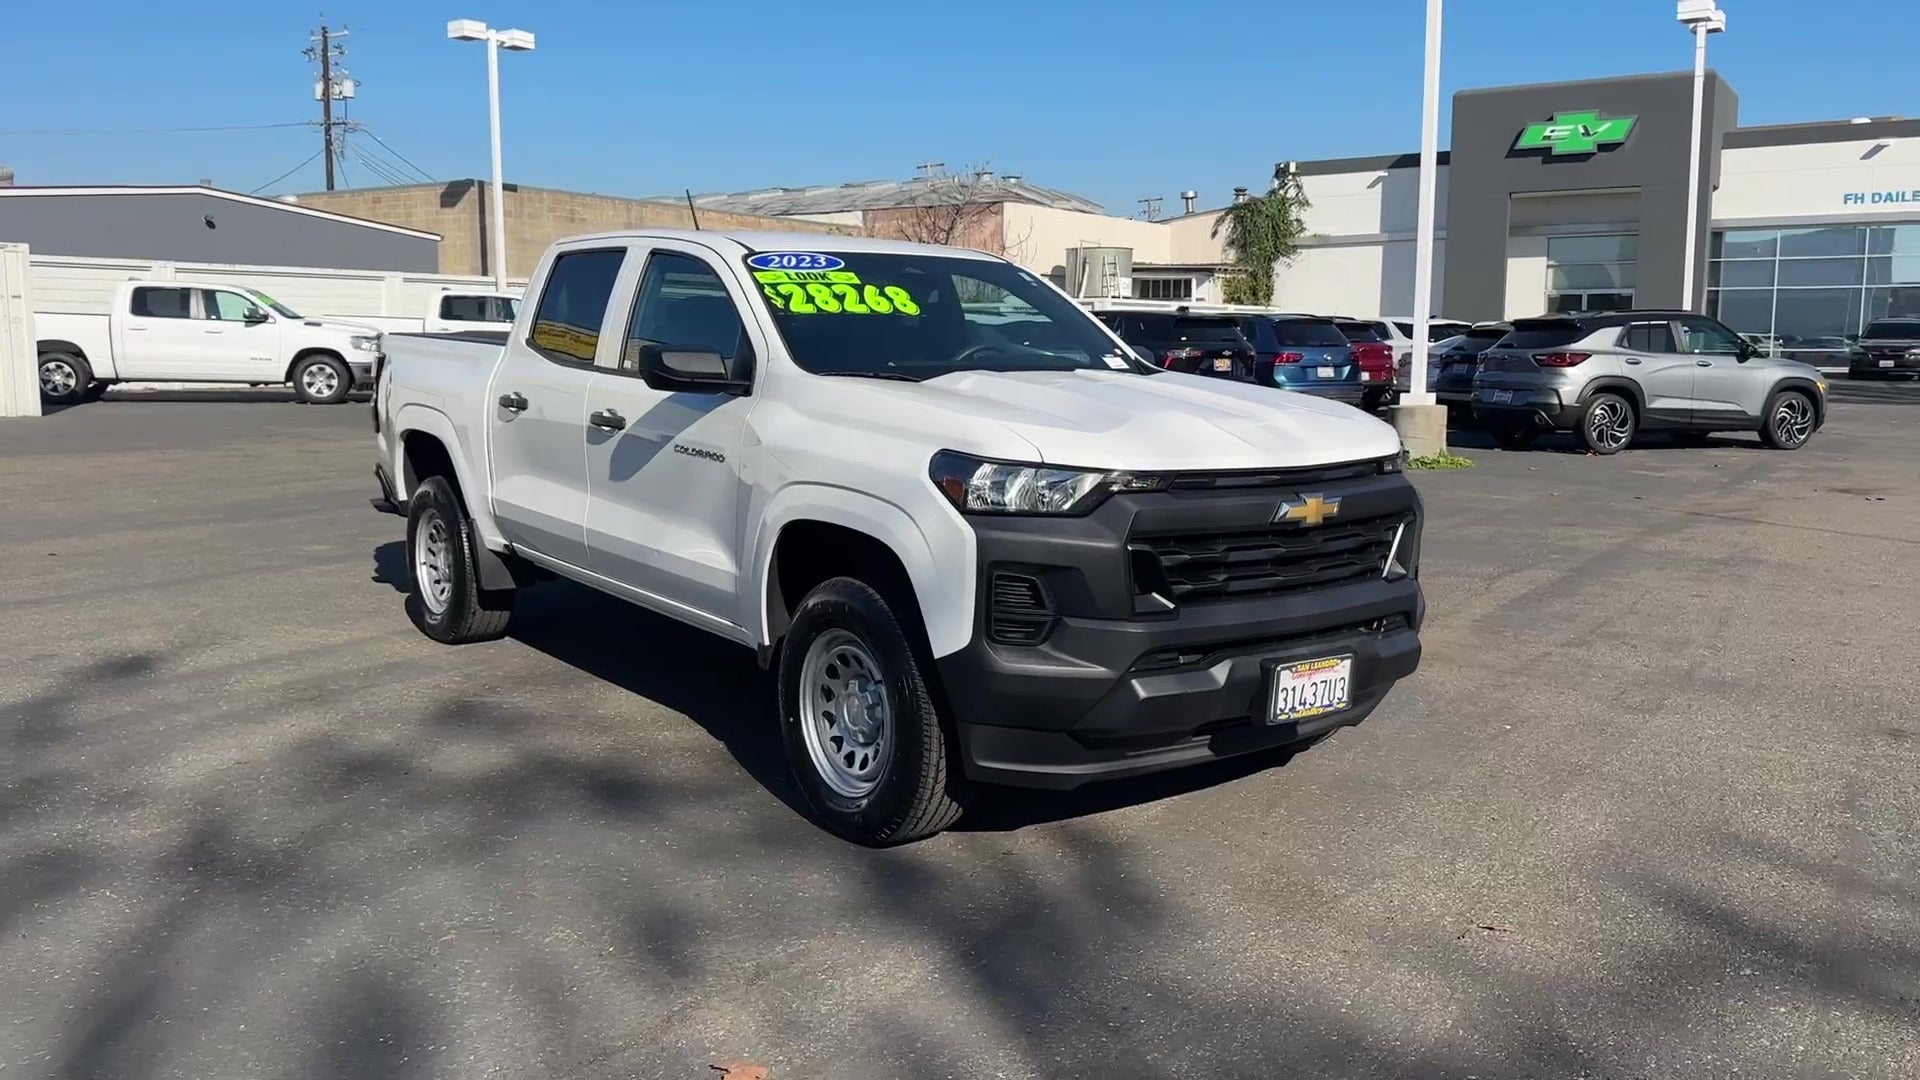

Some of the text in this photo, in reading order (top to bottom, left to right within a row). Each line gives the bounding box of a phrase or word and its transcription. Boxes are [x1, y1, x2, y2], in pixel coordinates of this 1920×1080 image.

[1541, 123, 1612, 144] EV
[1843, 191, 1920, 205] FH DAILE
[767, 255, 827, 268] 2023
[786, 271, 833, 282] LOOK
[763, 283, 921, 316] $28268
[673, 444, 726, 463] COLORADO
[1278, 676, 1346, 713] 31437U3
